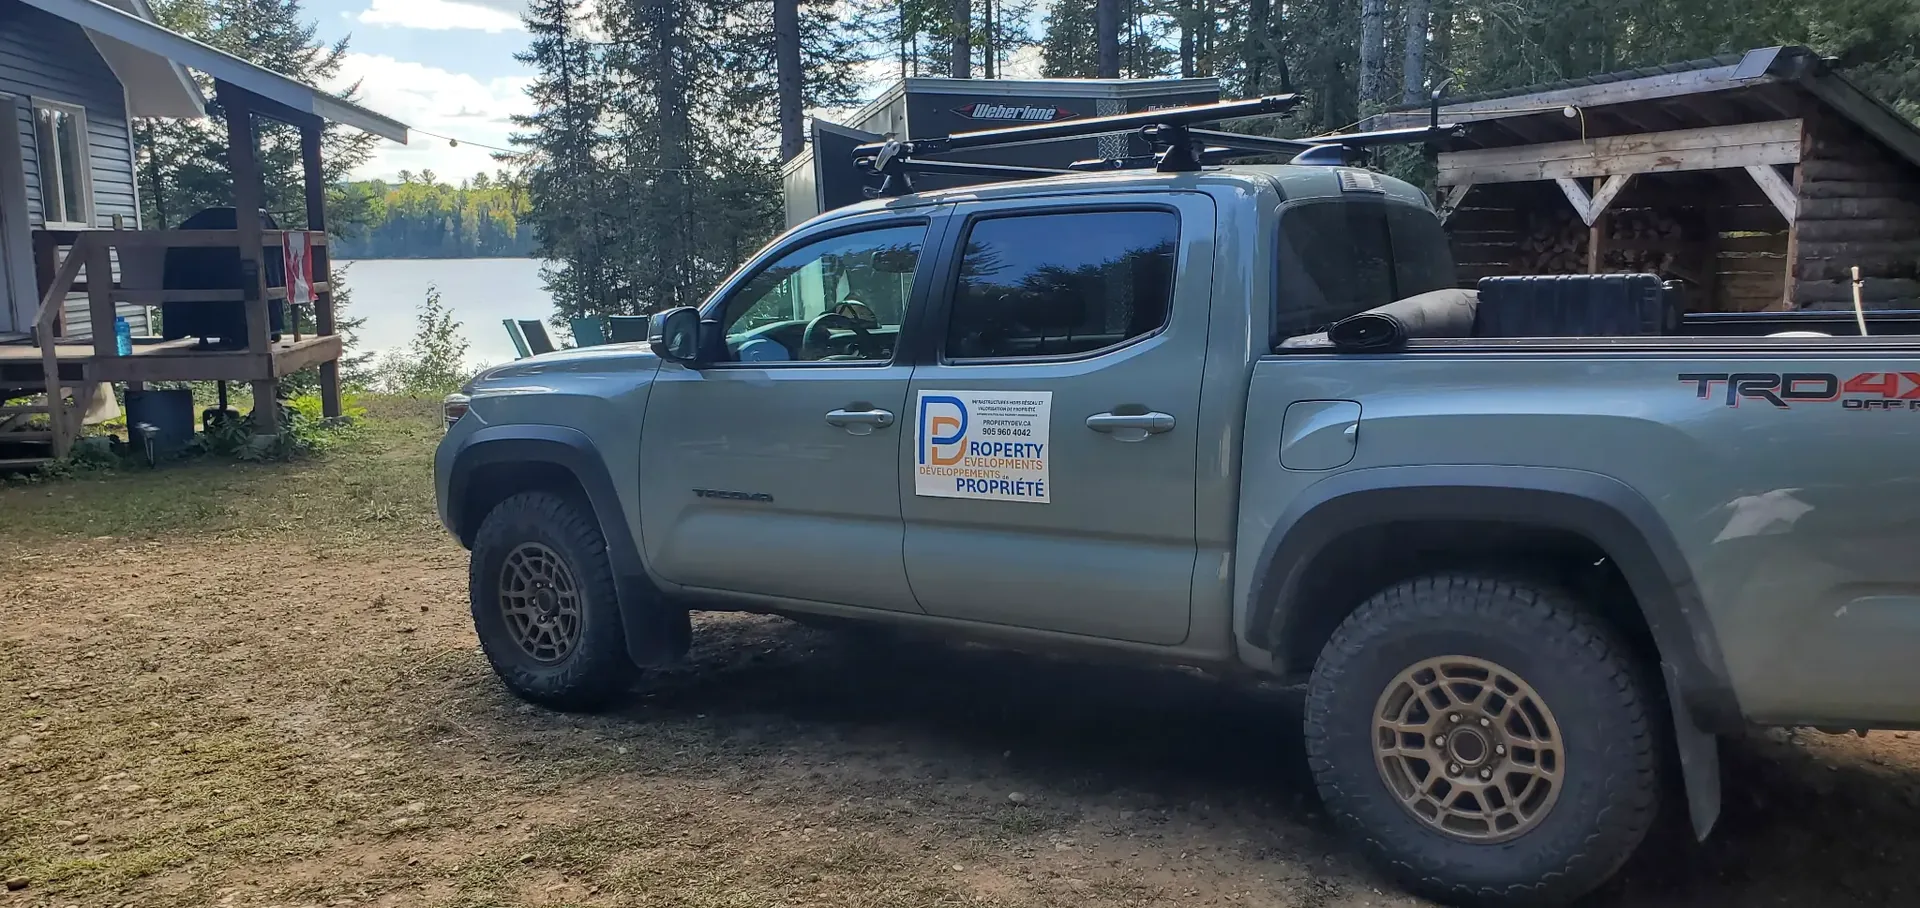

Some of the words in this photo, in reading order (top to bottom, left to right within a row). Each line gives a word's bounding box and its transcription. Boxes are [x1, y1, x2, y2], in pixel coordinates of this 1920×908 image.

[1678, 372, 1841, 409] TRD
[1842, 399, 1905, 411] OFF
[982, 419, 1032, 427] PROPERTYDEV.CA
[982, 427, 996, 436] 905
[997, 428, 1011, 436] 960
[1012, 428, 1031, 437] 4042
[919, 465, 1000, 479] DÉVELOPPEMENTS
[956, 477, 1045, 498] PROPRIÉTÉ
